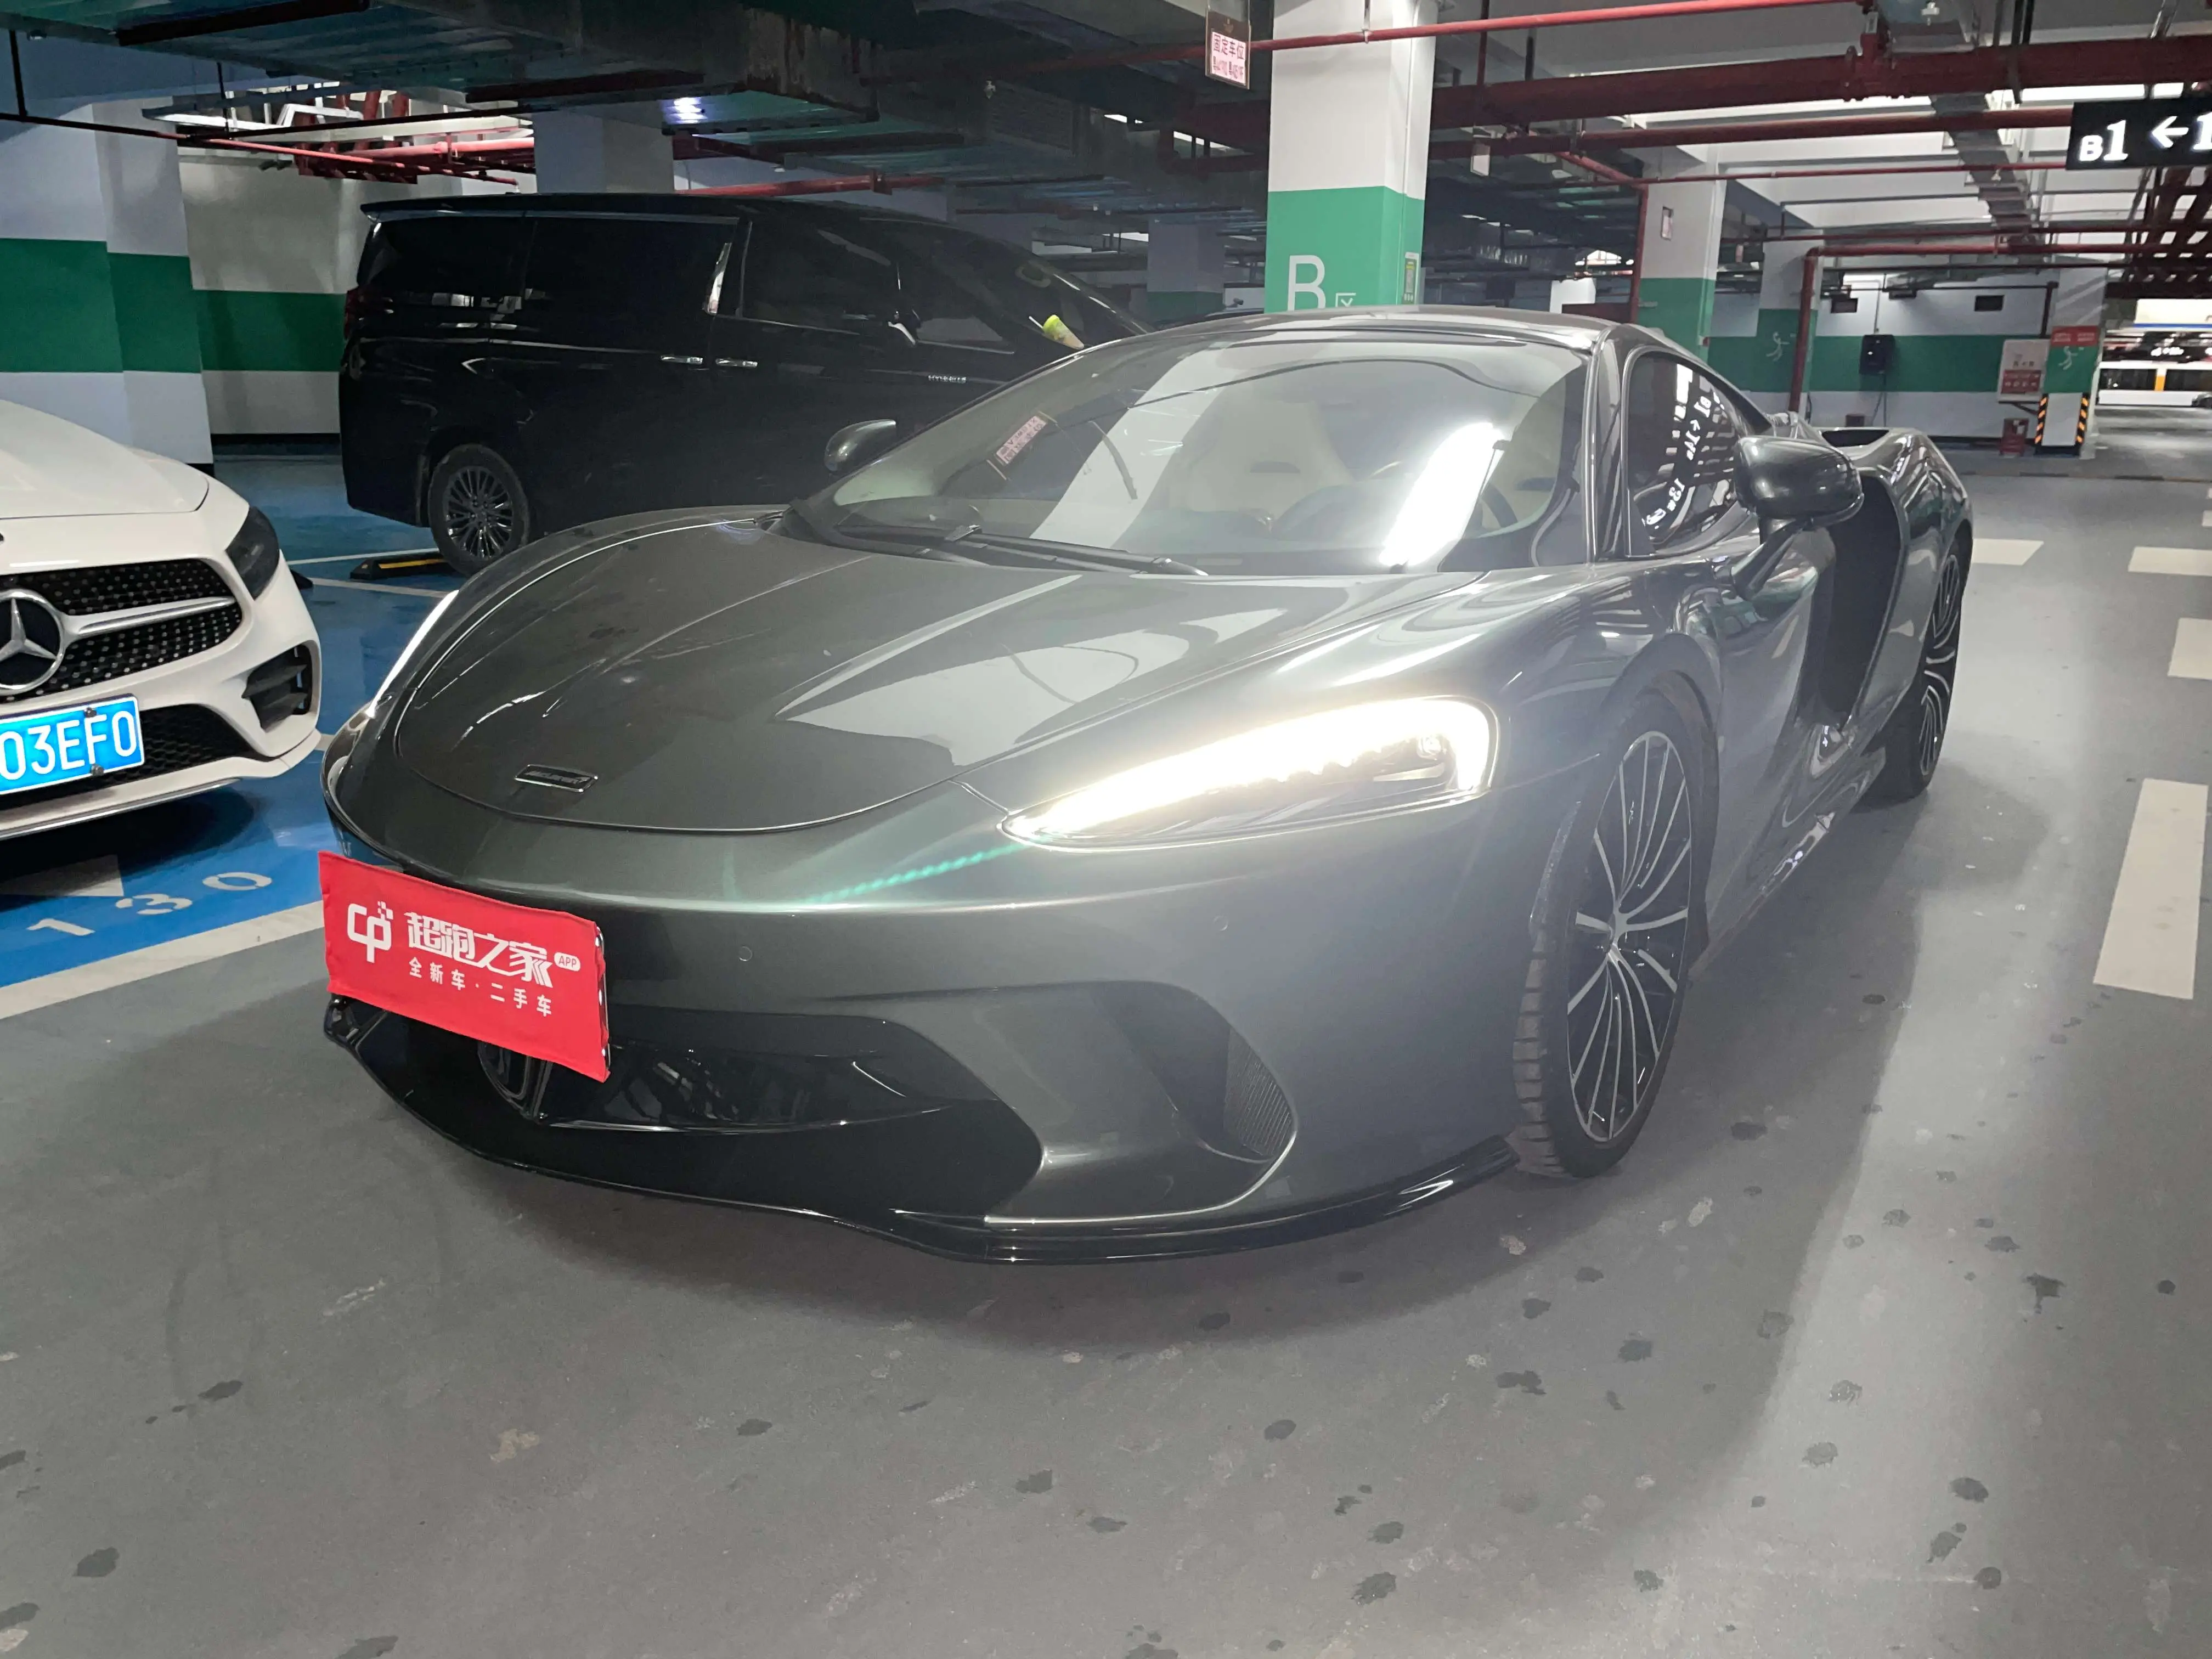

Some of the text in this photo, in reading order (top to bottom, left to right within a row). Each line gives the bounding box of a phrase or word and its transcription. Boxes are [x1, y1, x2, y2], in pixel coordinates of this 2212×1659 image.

[1212, 33, 1245, 60] 固定车位
[2079, 119, 2129, 161] B1
[26, 872, 273, 936] 130
[403, 911, 577, 988] 超跑之家 APP
